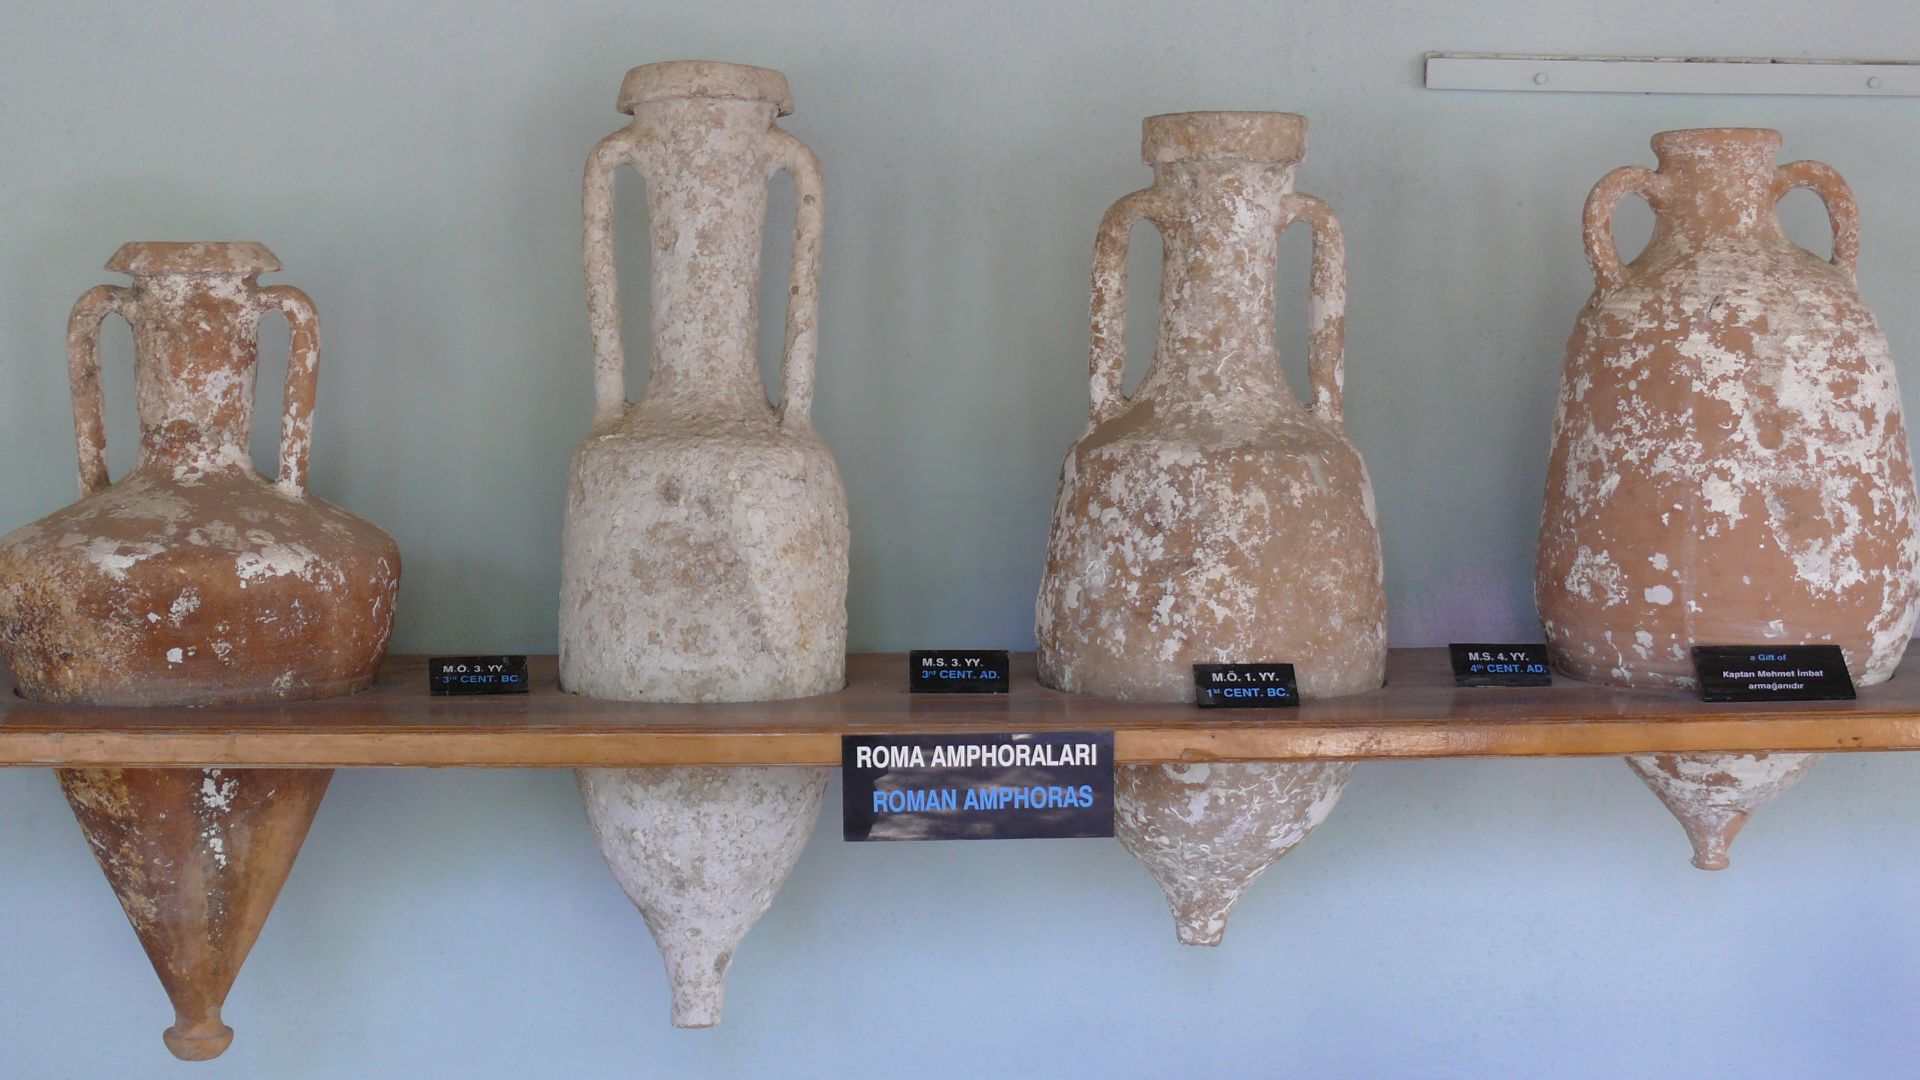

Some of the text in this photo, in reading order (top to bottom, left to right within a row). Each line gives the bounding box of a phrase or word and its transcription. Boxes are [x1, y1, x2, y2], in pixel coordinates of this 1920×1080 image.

[1468, 652, 1529, 661] M.S. 4. YY.
[1758, 653, 1775, 661] Gift
[1777, 653, 1787, 661] of
[922, 657, 983, 667] M.S. 3. YY.
[1470, 664, 1546, 673] 4th CENT. AD.
[1722, 668, 1823, 679] Kaptan Mehmet İmbat
[921, 670, 1000, 679] 3rd CENT. AD.
[1211, 670, 1279, 682] M.Ö. 1. YY.
[1748, 682, 1804, 691] armağanıdır
[1223, 688, 1264, 697] CENT.
[1267, 687, 1290, 697] BC.
[856, 743, 1097, 768] ROMA AMPHORALARI
[873, 784, 1094, 813] ROMAN AMPHORAS
